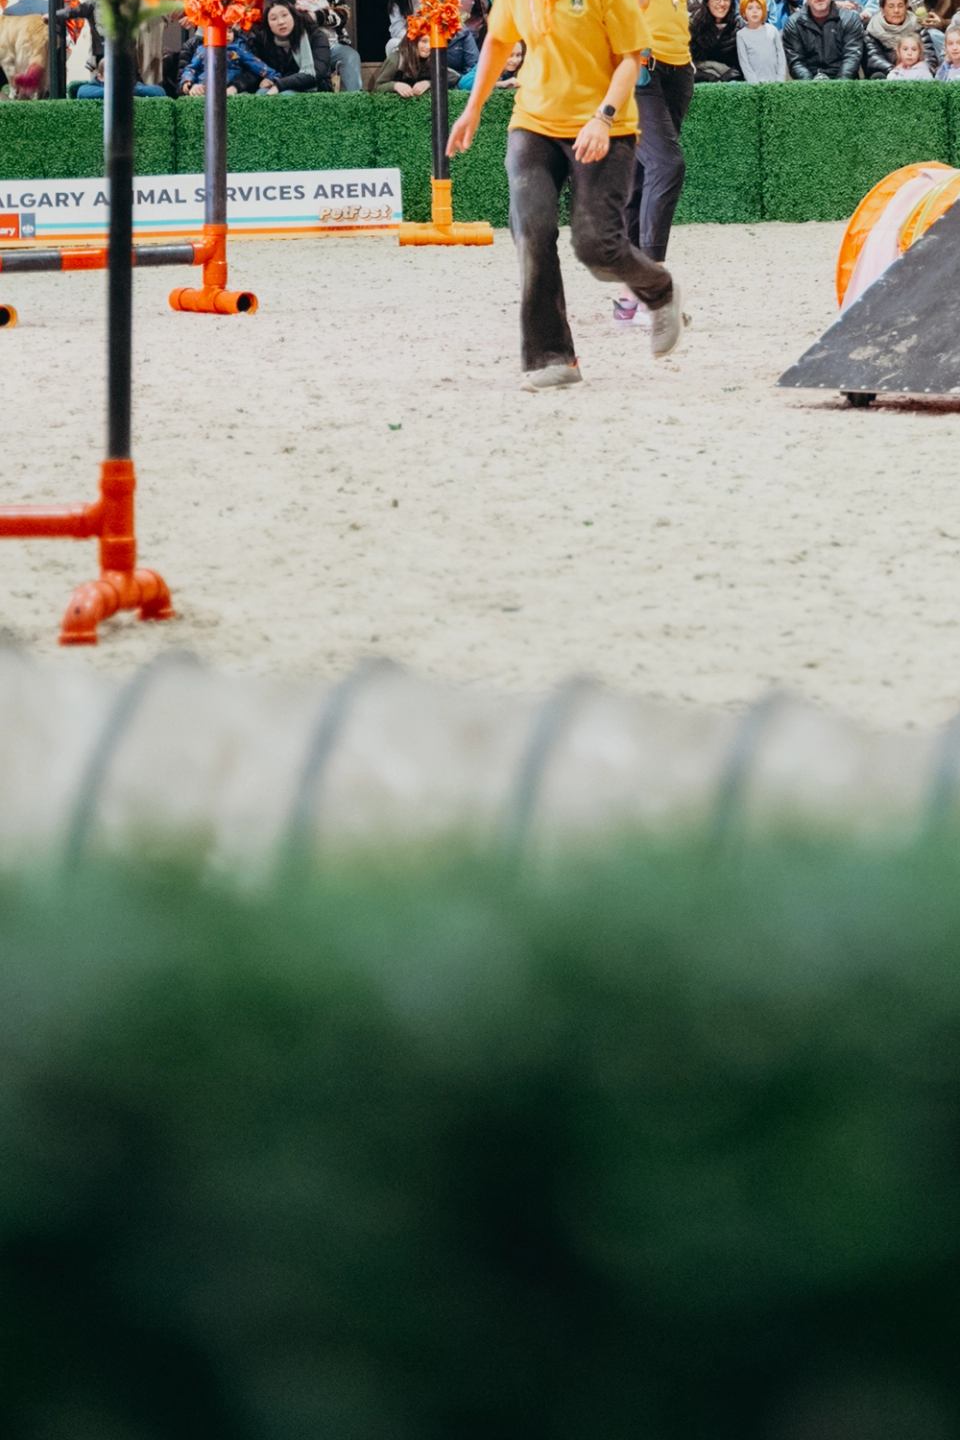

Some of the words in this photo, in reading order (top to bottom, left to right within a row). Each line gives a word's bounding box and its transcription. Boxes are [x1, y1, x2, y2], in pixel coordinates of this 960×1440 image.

[93, 188, 187, 206] AIMAL
[194, 184, 305, 203] SRVICES
[313, 181, 394, 199] ARENA
